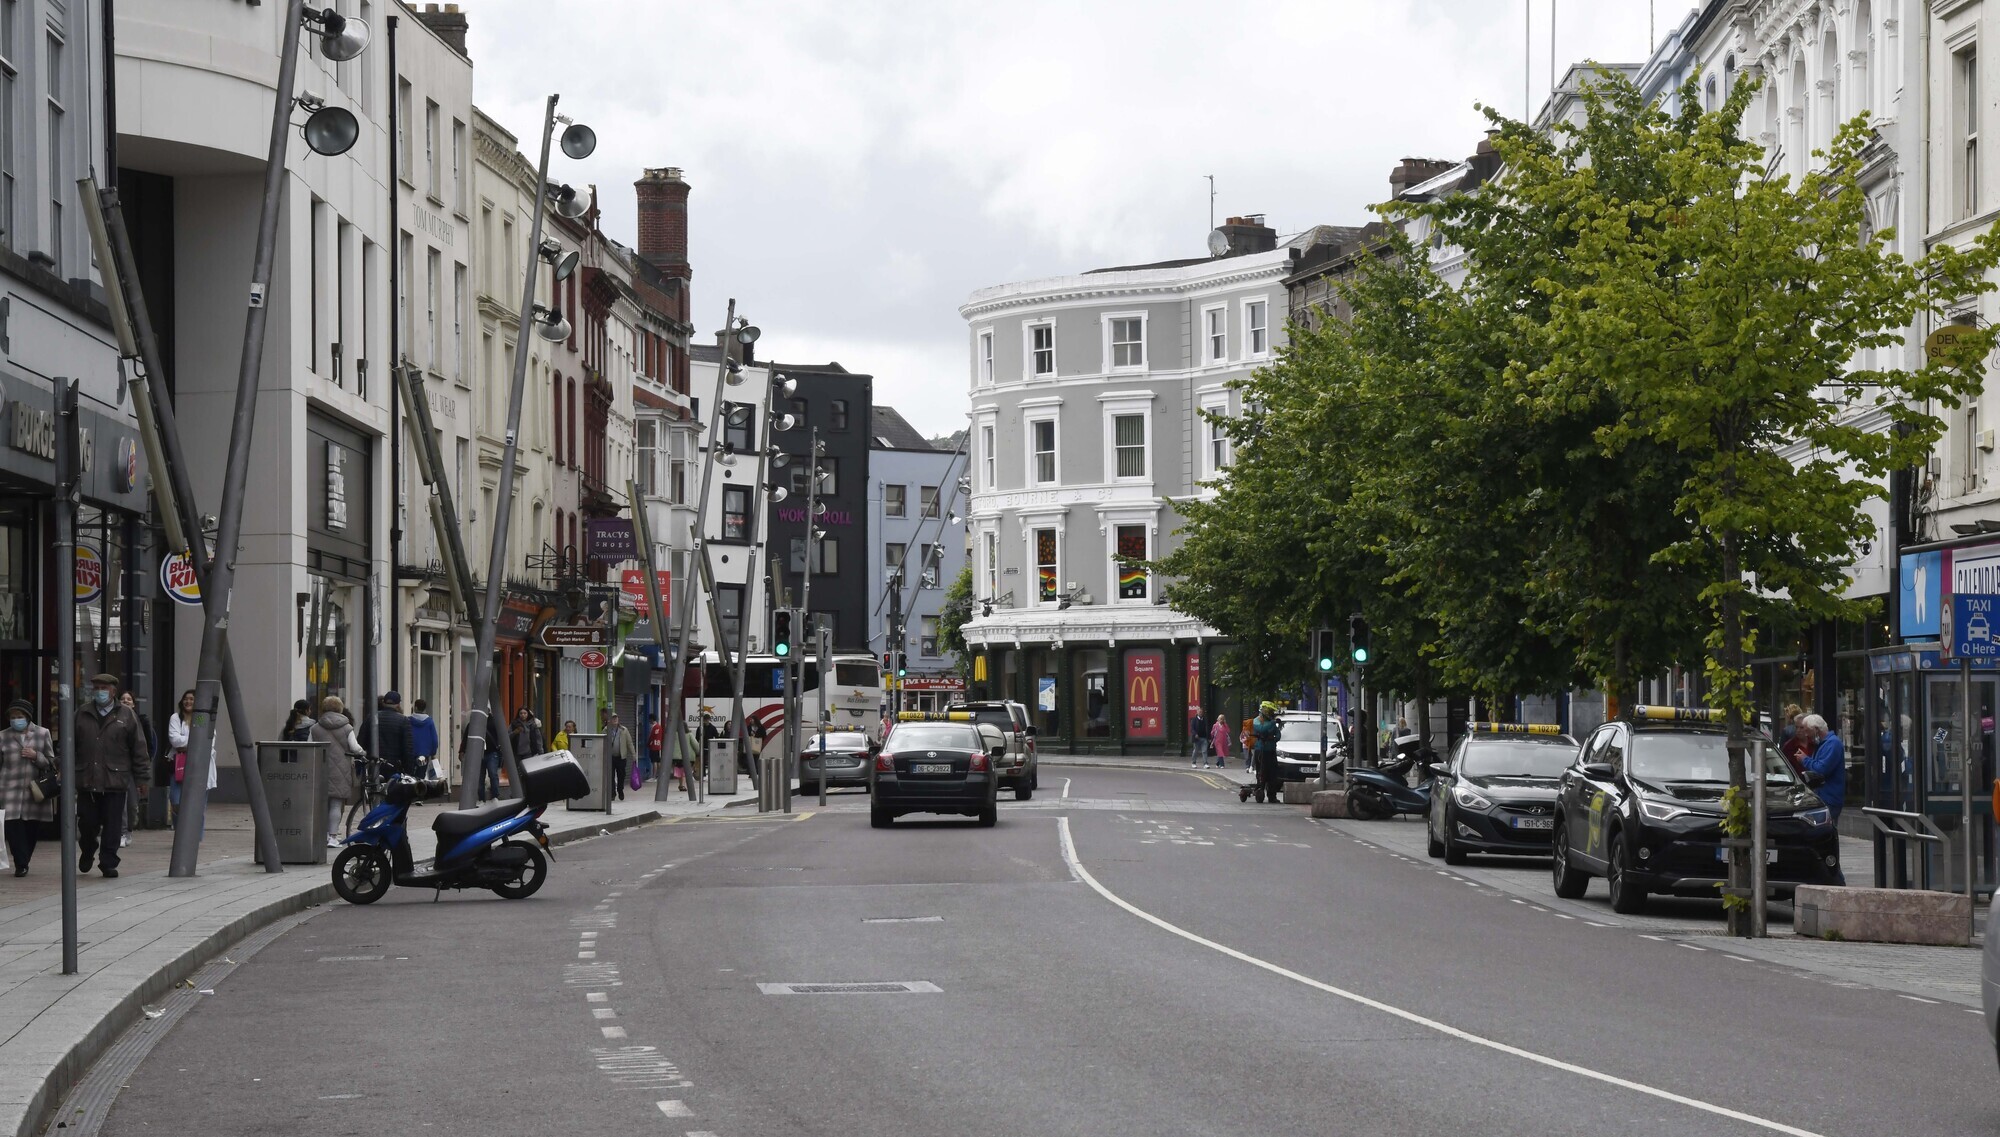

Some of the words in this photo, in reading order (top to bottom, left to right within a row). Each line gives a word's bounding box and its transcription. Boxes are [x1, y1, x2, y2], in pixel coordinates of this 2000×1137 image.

[412, 203, 427, 231] TOM
[428, 213, 454, 246] MURPHY
[15, 401, 55, 460] BURGE
[1006, 490, 1058, 506] BOURNE
[1073, 489, 1082, 500] &
[778, 508, 806, 522] WOK
[823, 511, 852, 526] ROLL
[596, 531, 630, 539] TRACYS
[169, 570, 198, 589] KI
[1966, 599, 1991, 612] TAXI
[1961, 644, 1971, 655] Q
[1973, 643, 1996, 654] Here
[904, 678, 965, 686] MUSA'S
[1637, 705, 1646, 715] C
[1677, 707, 1708, 719] TAXI
[1503, 723, 1524, 732] TAXI
[1537, 725, 1558, 734] 10273
[267, 772, 308, 780] BRUSCAR
